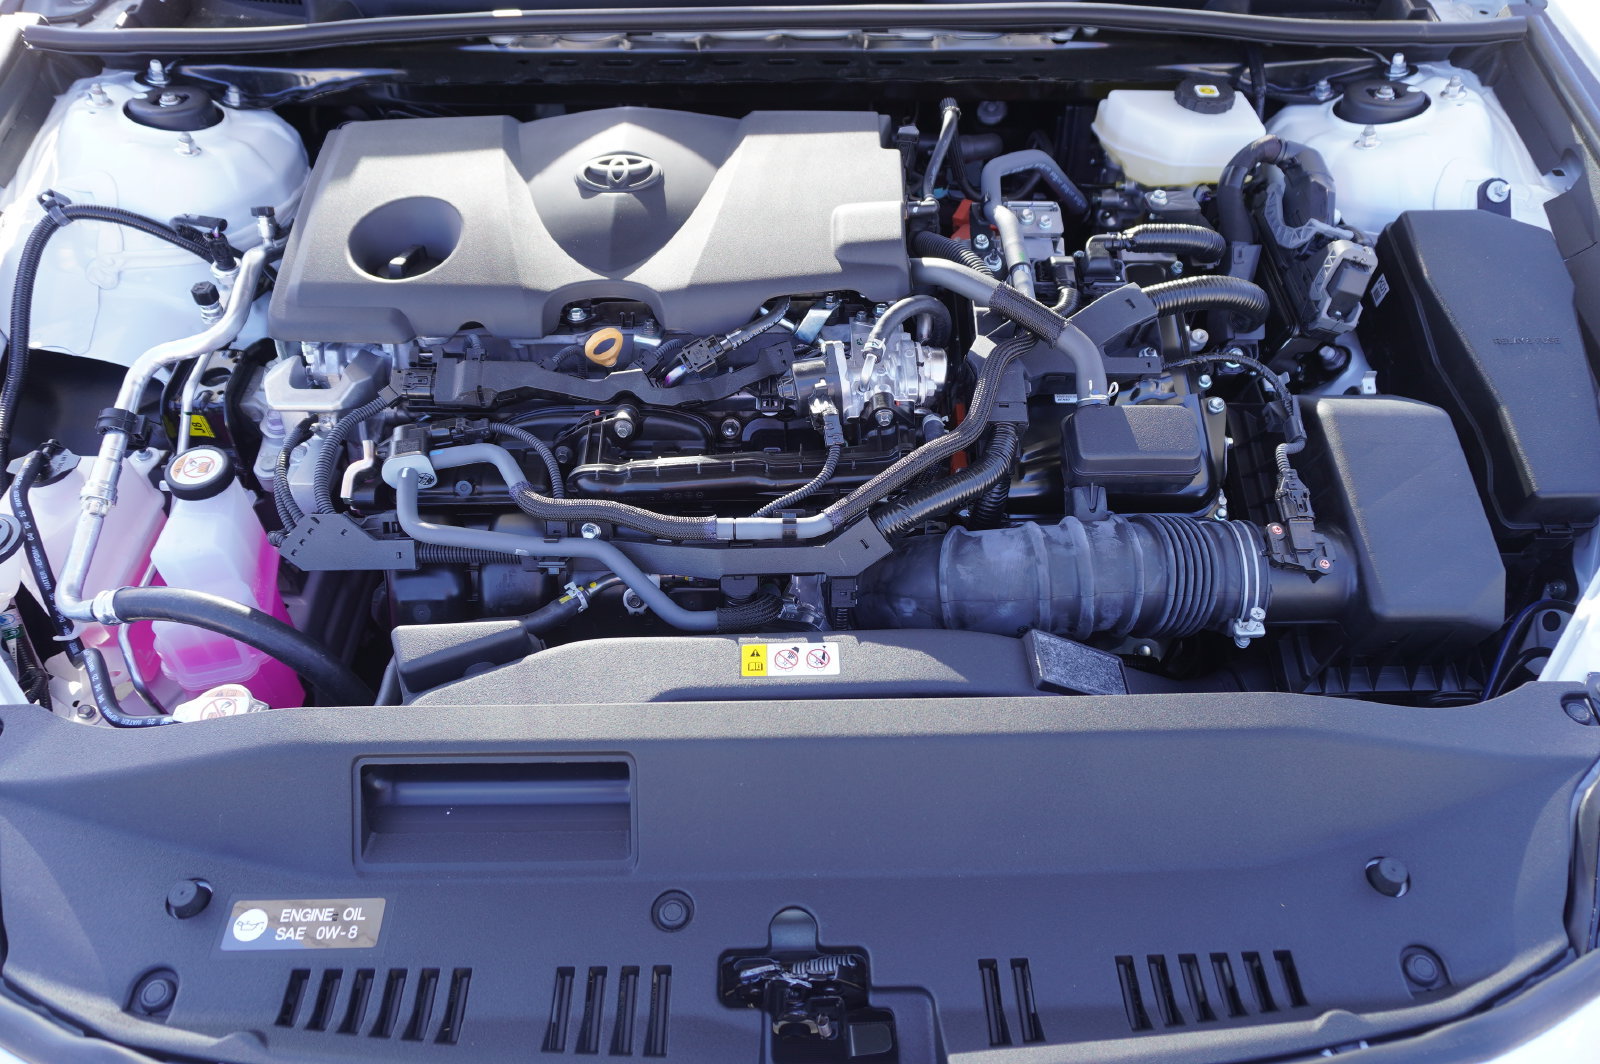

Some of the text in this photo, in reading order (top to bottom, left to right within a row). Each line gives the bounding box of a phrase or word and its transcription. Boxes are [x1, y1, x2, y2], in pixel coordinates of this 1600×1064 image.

[280, 907, 366, 923] ENGINE OIL
[274, 925, 359, 941] SAE 0W-8
